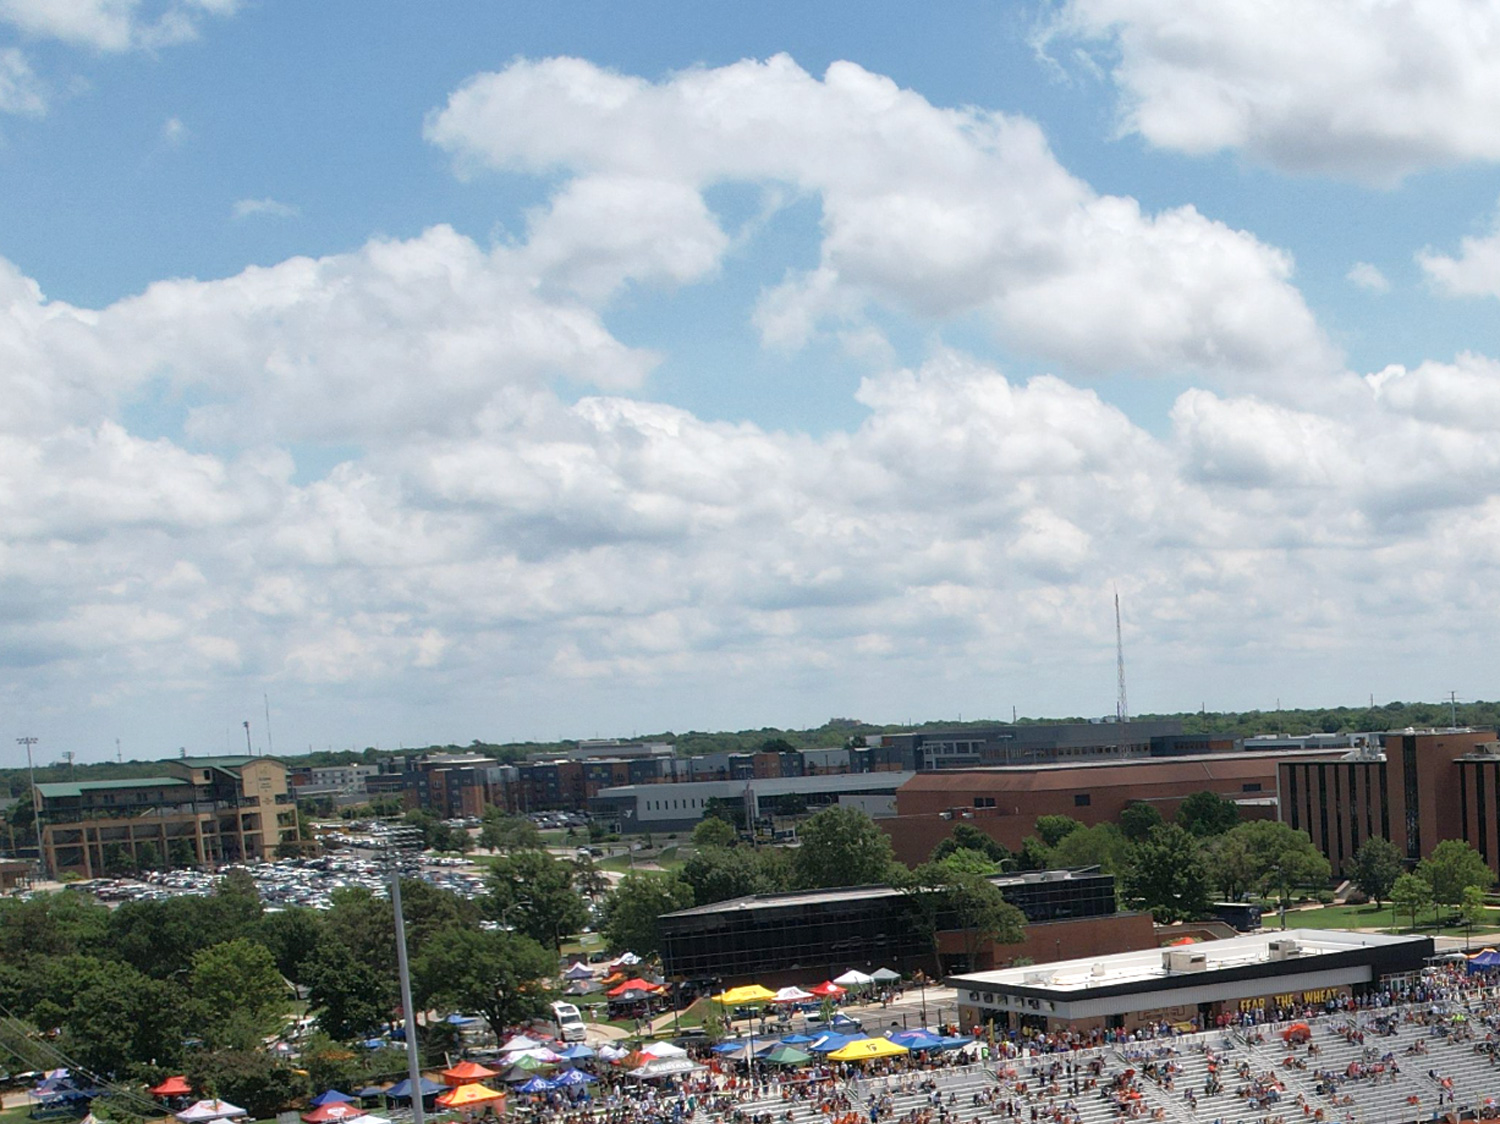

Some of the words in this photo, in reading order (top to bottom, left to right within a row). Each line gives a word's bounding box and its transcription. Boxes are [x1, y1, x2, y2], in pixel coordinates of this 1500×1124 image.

[1239, 997, 1266, 1012] FEAR
[1274, 994, 1295, 1008] THE
[1302, 988, 1338, 1004] WHEAT
